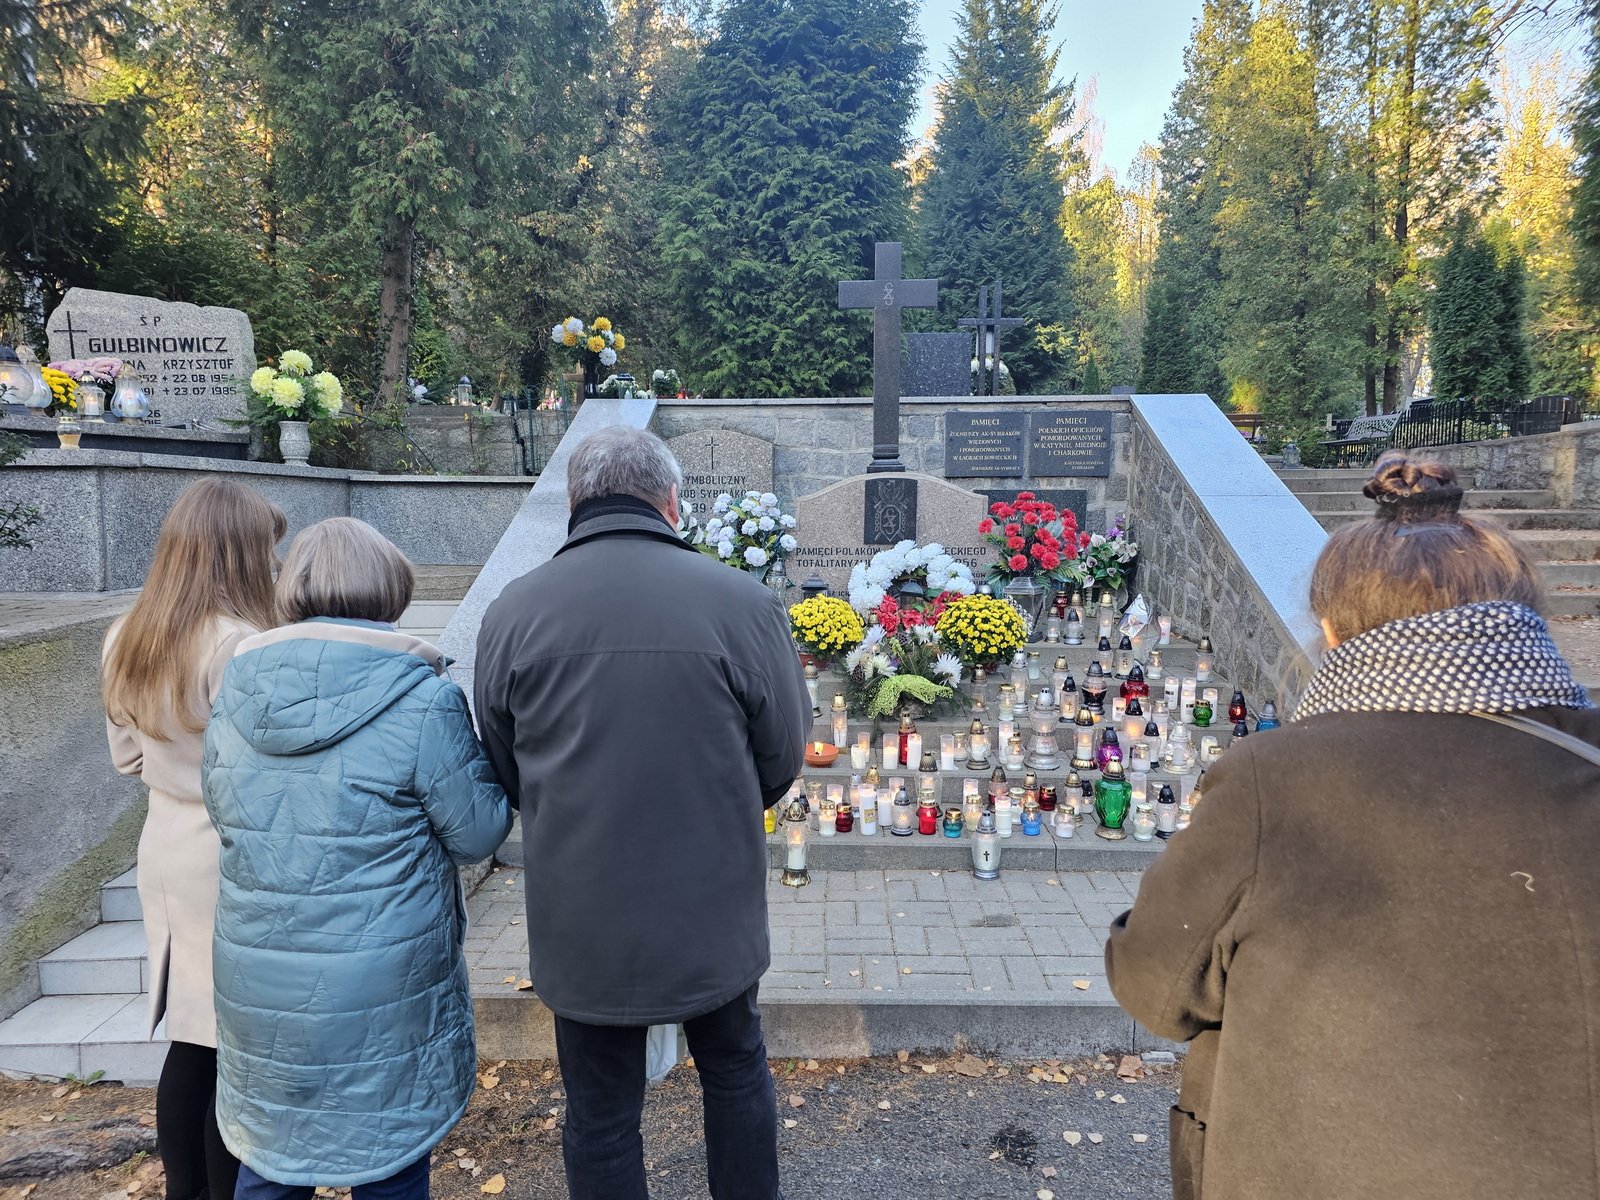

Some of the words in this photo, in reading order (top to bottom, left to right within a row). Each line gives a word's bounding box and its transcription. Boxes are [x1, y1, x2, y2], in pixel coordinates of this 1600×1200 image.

[153, 316, 161, 327] P
[88, 337, 228, 353] GULBINOWICZ
[163, 358, 234, 370] KRZYSZTOF
[682, 475, 747, 485] YMBOLICZNY
[796, 547, 833, 557] PAMIĘCI
